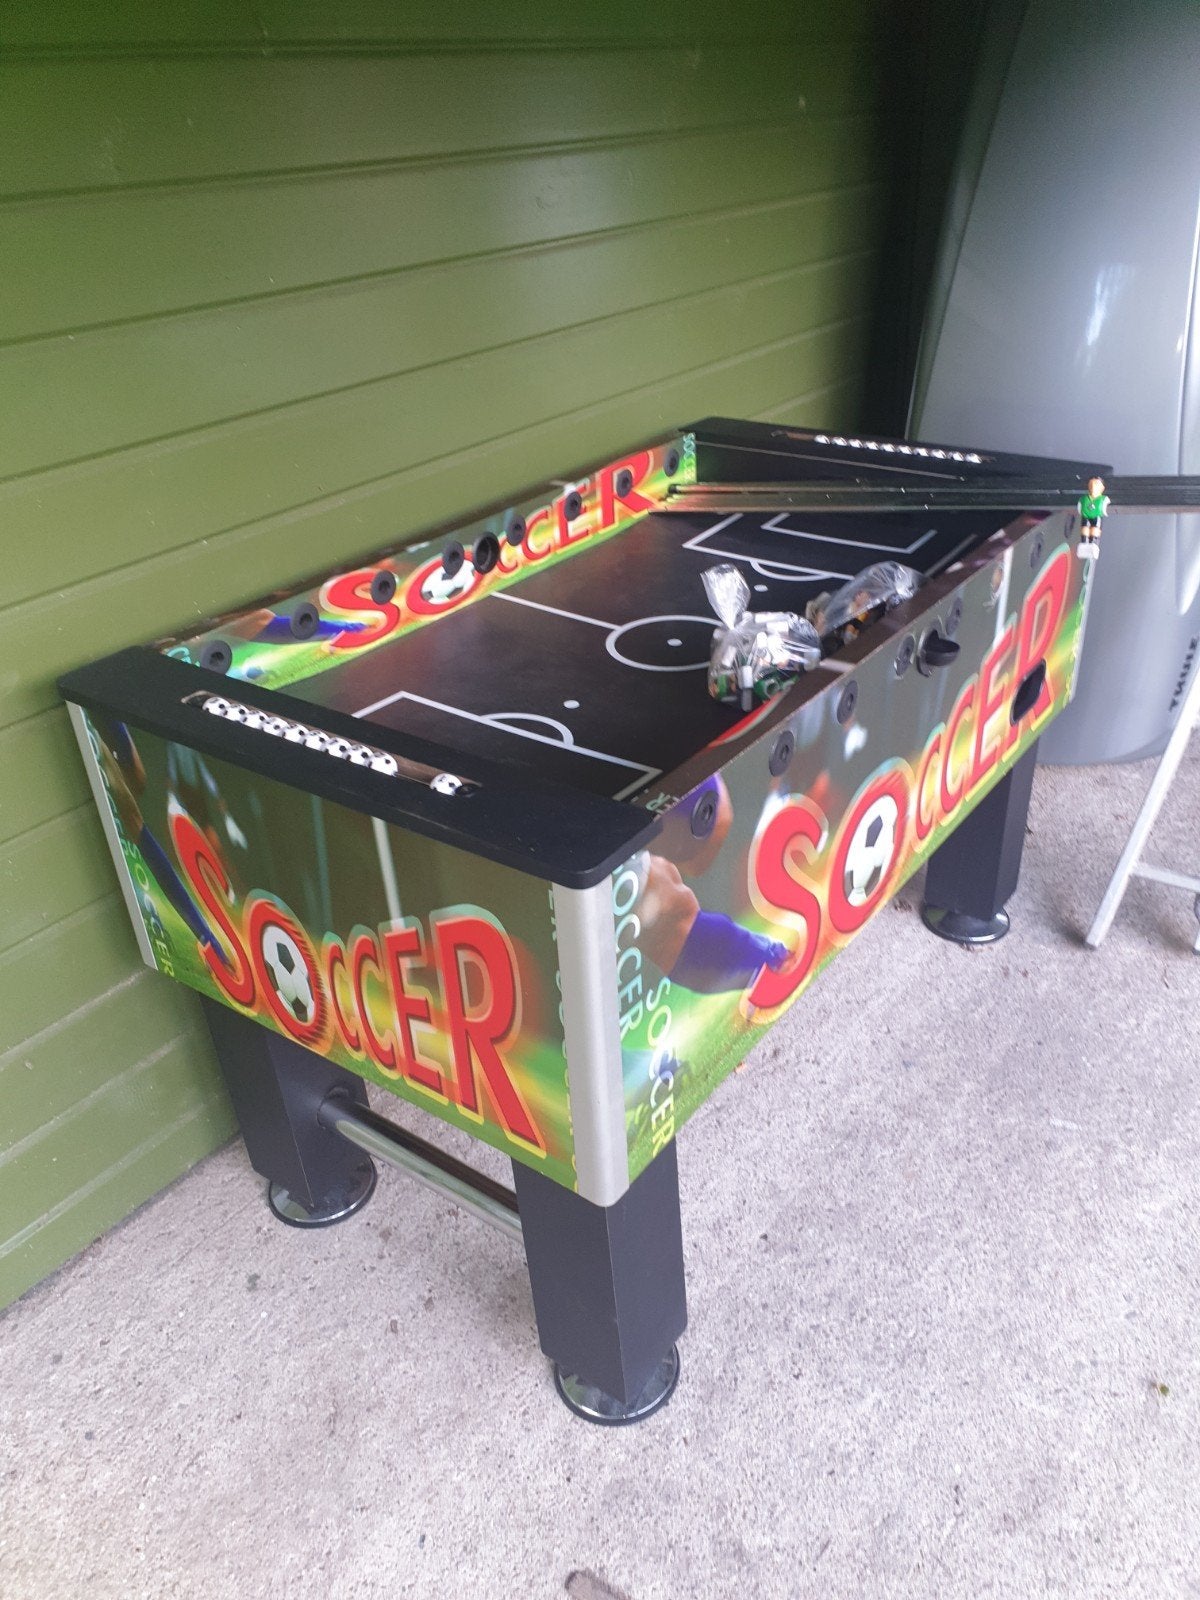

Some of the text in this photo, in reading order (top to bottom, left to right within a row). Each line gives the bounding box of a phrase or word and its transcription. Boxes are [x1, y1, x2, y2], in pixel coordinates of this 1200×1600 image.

[322, 450, 656, 650] SOCCER
[746, 545, 1073, 1012] SOCCER
[126, 843, 175, 978] SOCCER
[168, 812, 548, 1160] SOCCER
[611, 855, 643, 1041] OCCER
[646, 976, 675, 1159] SOCCER
